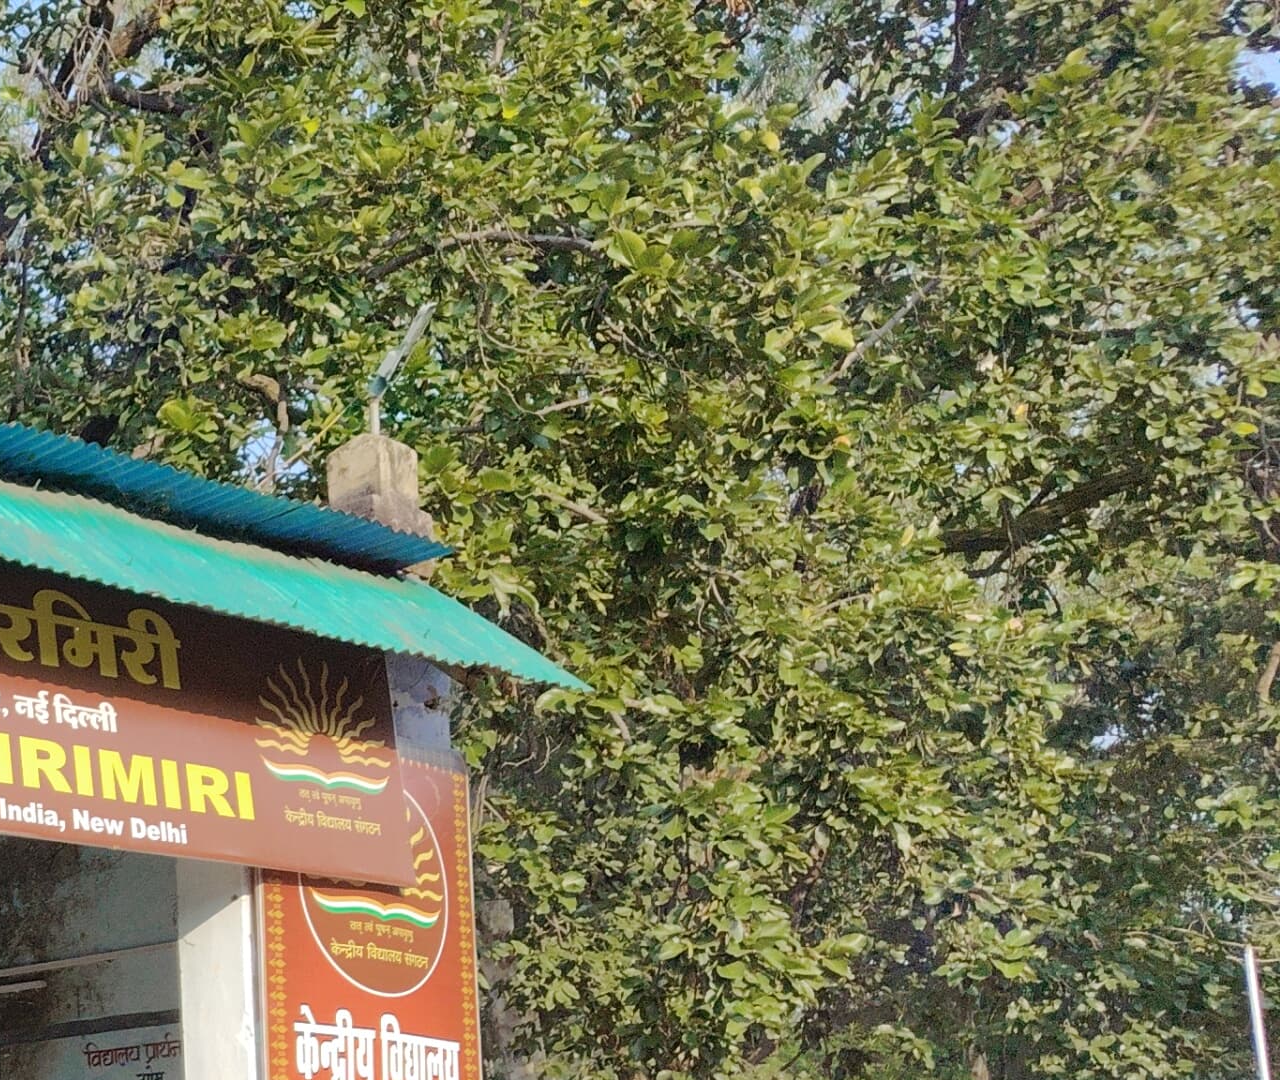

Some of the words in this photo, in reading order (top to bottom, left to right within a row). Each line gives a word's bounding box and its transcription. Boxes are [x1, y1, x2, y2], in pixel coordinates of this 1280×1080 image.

[14, 691, 50, 722] नई
[53, 693, 118, 734] दिल्ली
[0, 798, 67, 834] India,
[72, 809, 124, 838] New
[130, 818, 188, 846] Delhi
[317, 811, 353, 832] विद्यालय
[330, 937, 364, 960] केन्द्रीय
[367, 942, 403, 965] विद्यालय
[404, 948, 429, 969] संगठन
[84, 1042, 140, 1068] विद्यालय
